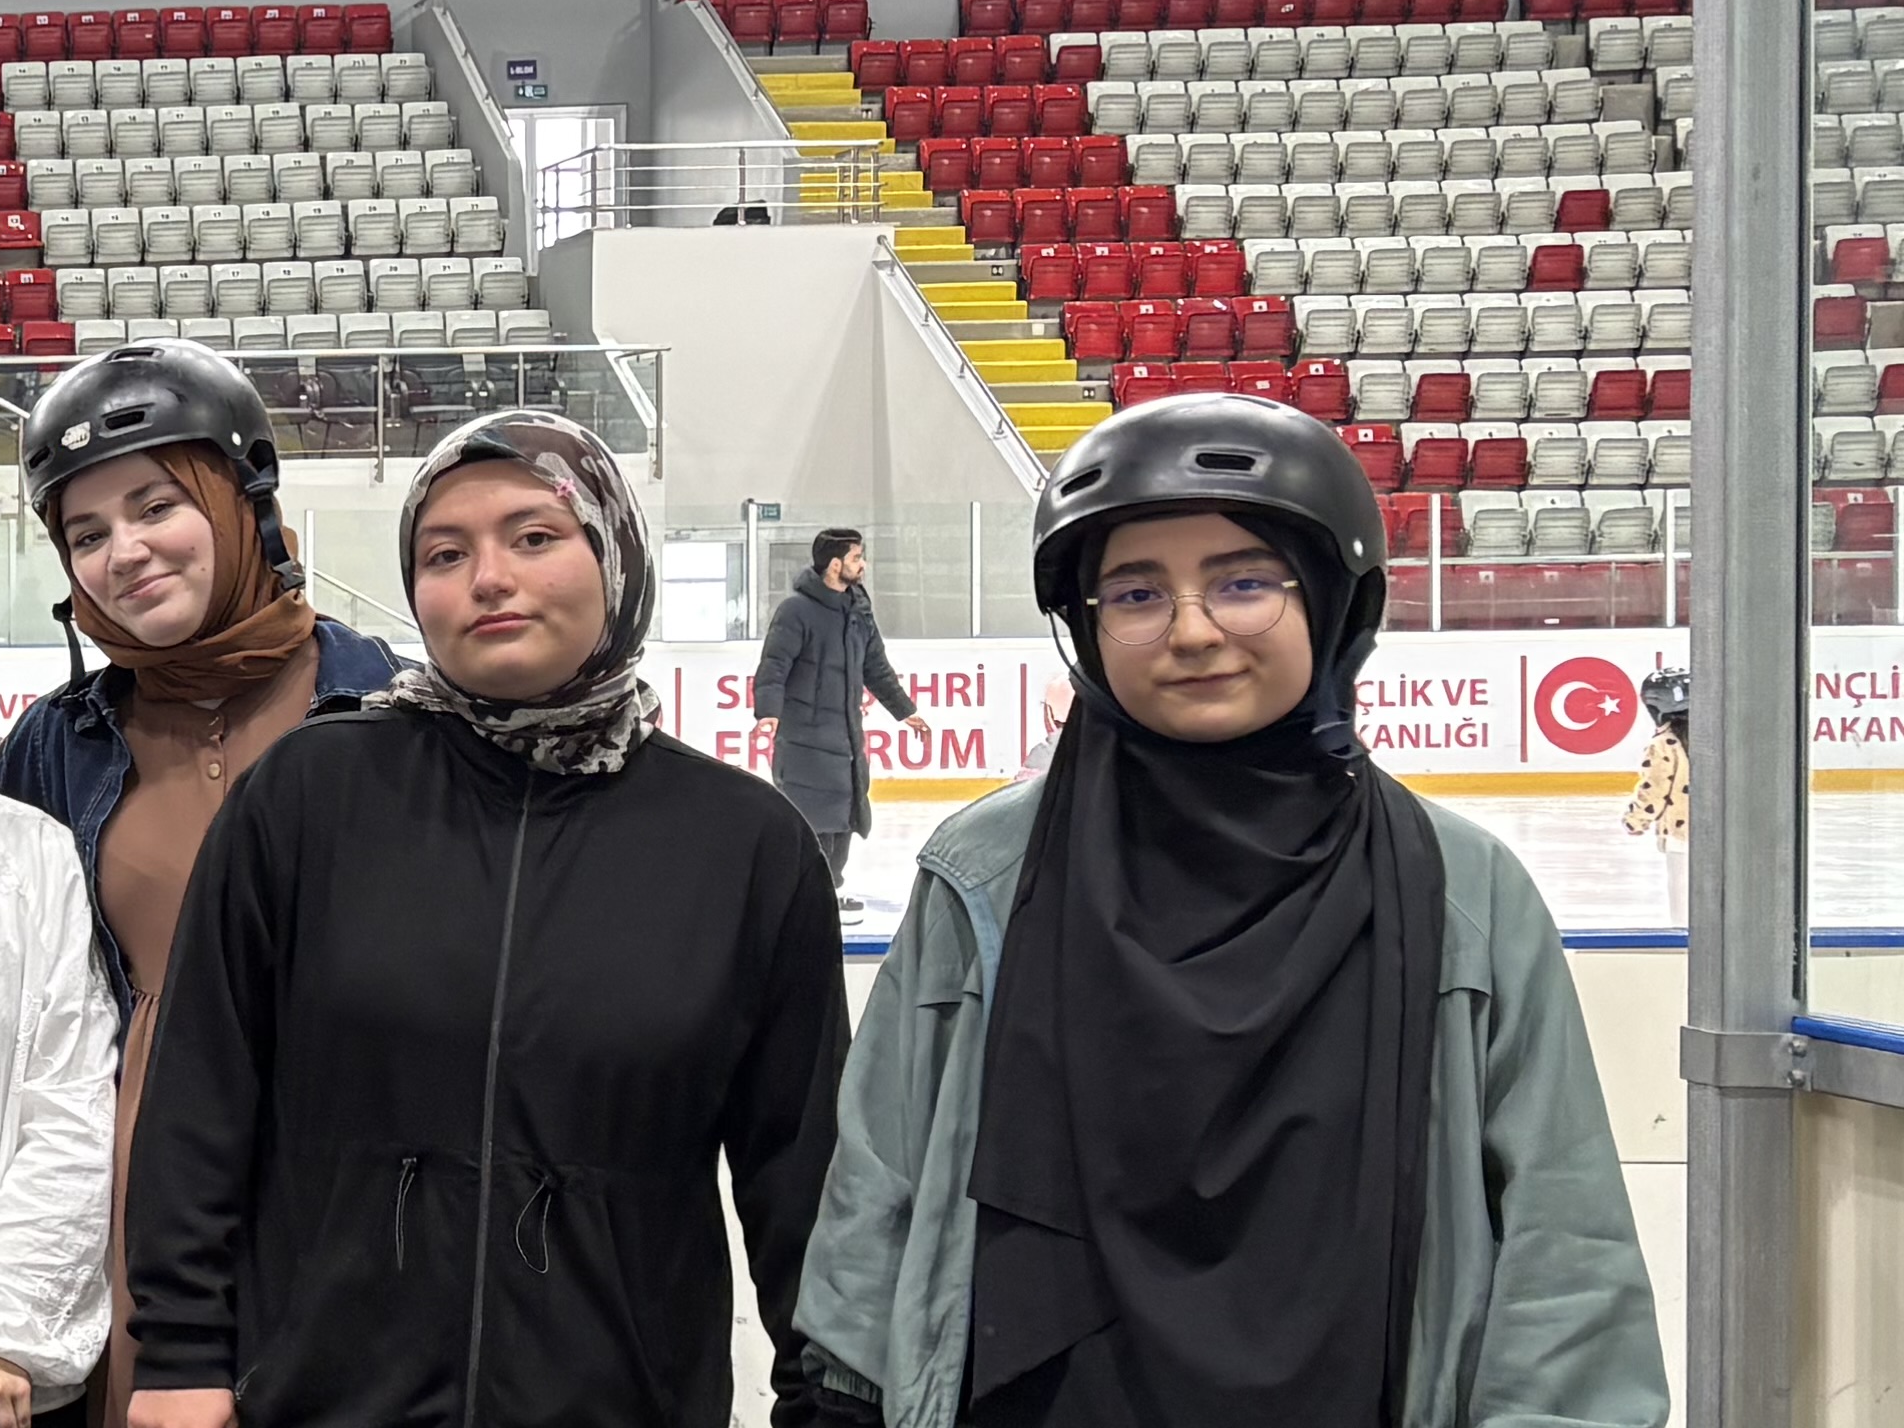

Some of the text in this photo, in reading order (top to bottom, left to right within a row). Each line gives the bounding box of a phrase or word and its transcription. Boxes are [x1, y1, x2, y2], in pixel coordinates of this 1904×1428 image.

[1356, 673, 1489, 716] ÇLİK VE
[1815, 665, 1900, 708] NÇLİ
[715, 729, 986, 771] ERRUM
[1360, 717, 1489, 749] ANLIĞI
